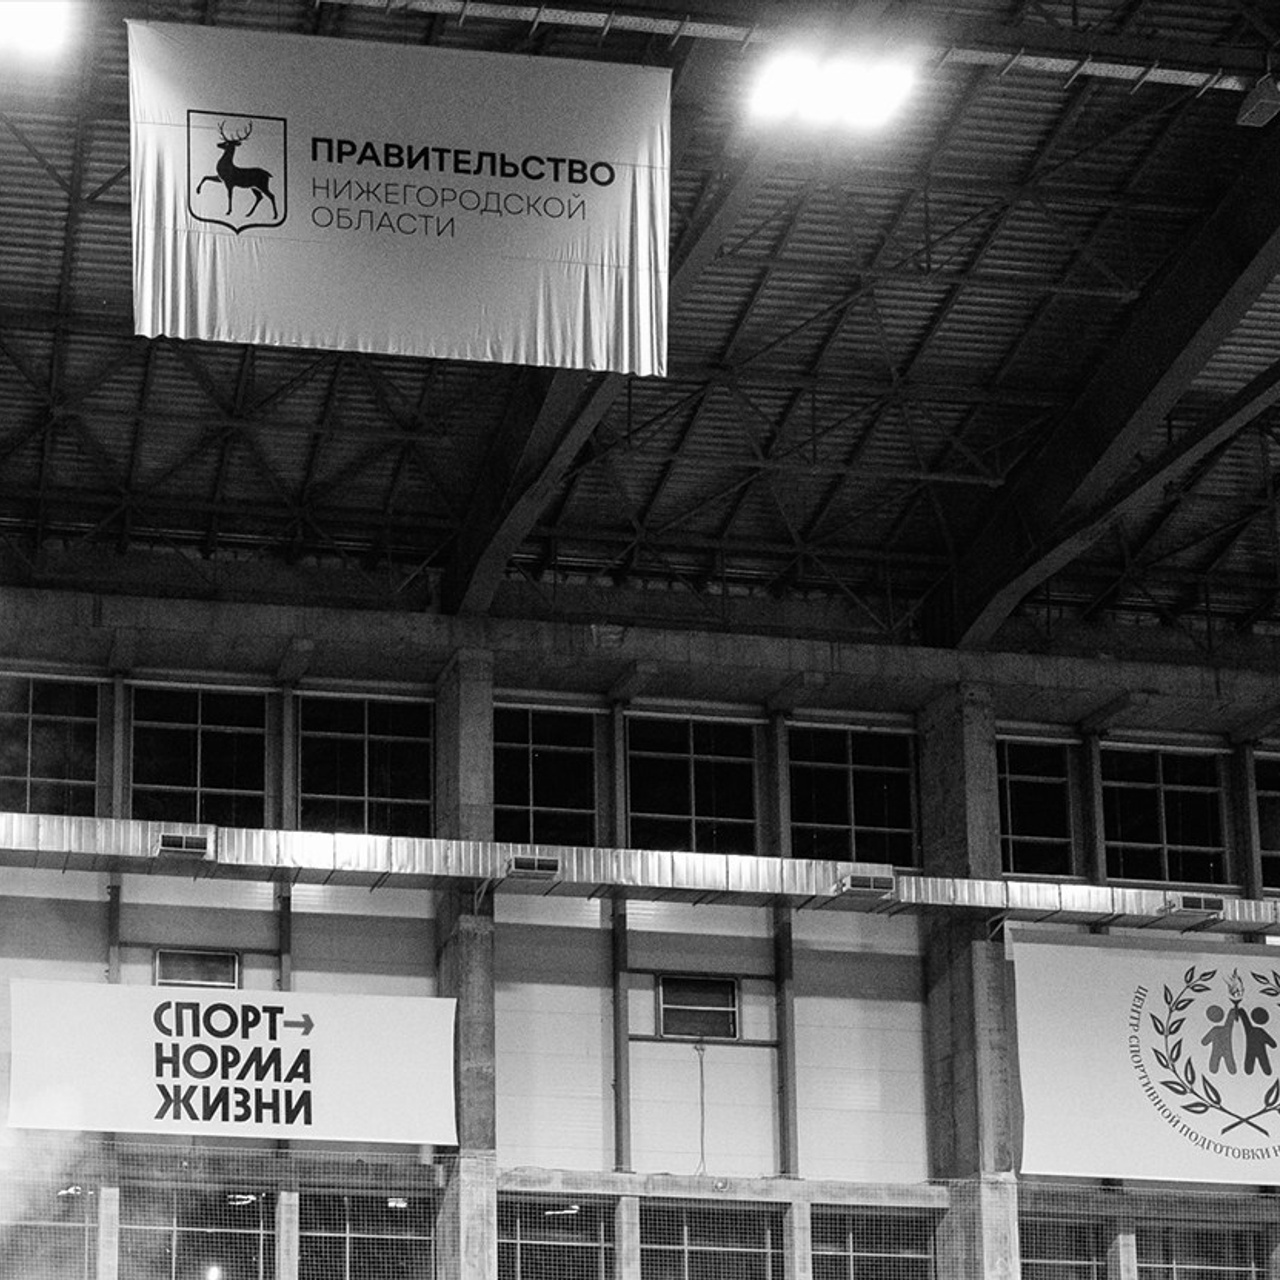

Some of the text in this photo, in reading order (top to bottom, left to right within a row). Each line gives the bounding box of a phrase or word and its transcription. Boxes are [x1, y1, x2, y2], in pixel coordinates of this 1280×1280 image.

[311, 137, 615, 187] ПРАВИТЕЛЬСТВО
[312, 178, 587, 221] НИЖЕГОРОДСКОЙ
[312, 206, 456, 238] ОБЛАСТИ
[153, 1000, 284, 1041] СПОРТ
[1128, 985, 1149, 1032] ЦЕНТР
[154, 1042, 312, 1083] НОРМА
[1128, 1034, 1181, 1128] СПОРТИВНОЙ
[154, 1084, 313, 1126] ЖИЗНИ
[1179, 1124, 1271, 1160] ПОДГОТОВКИ
